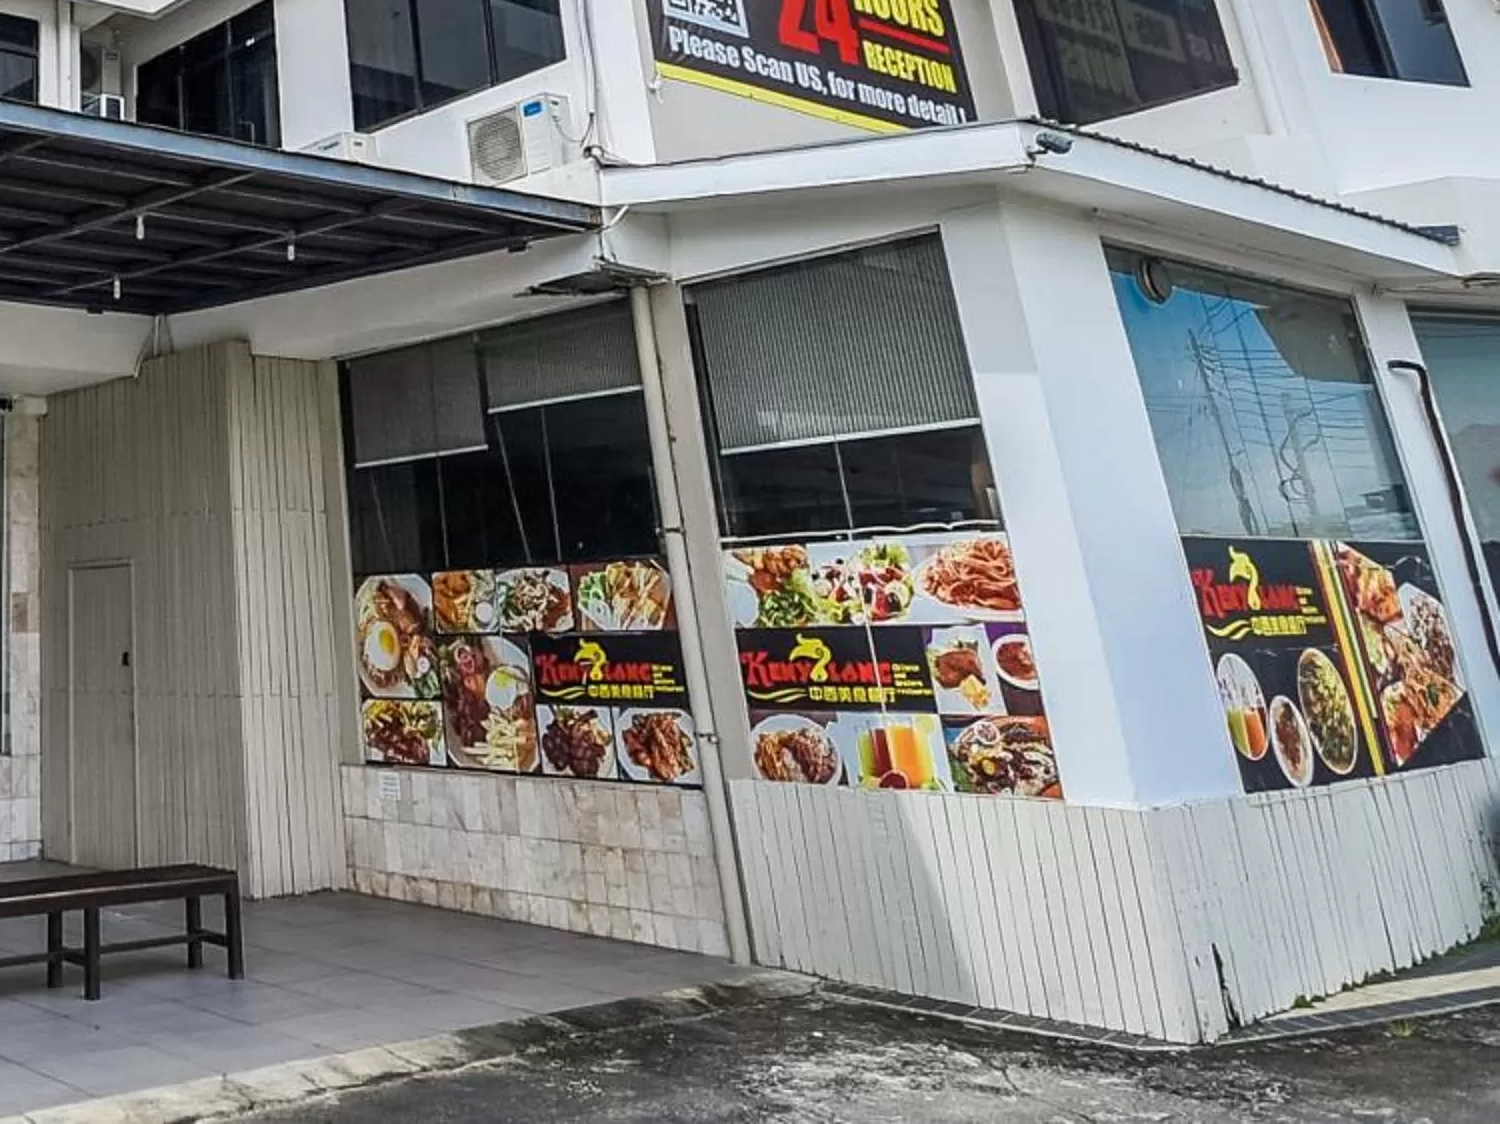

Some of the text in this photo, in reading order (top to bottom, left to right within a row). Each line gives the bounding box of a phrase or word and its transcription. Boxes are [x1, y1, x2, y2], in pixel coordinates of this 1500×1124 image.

[667, 25, 741, 68] Please
[744, 44, 792, 85] Scan
[794, 61, 828, 95] US,
[828, 70, 856, 102] for
[859, 82, 913, 114] more
[862, 39, 957, 94] RECEPTION
